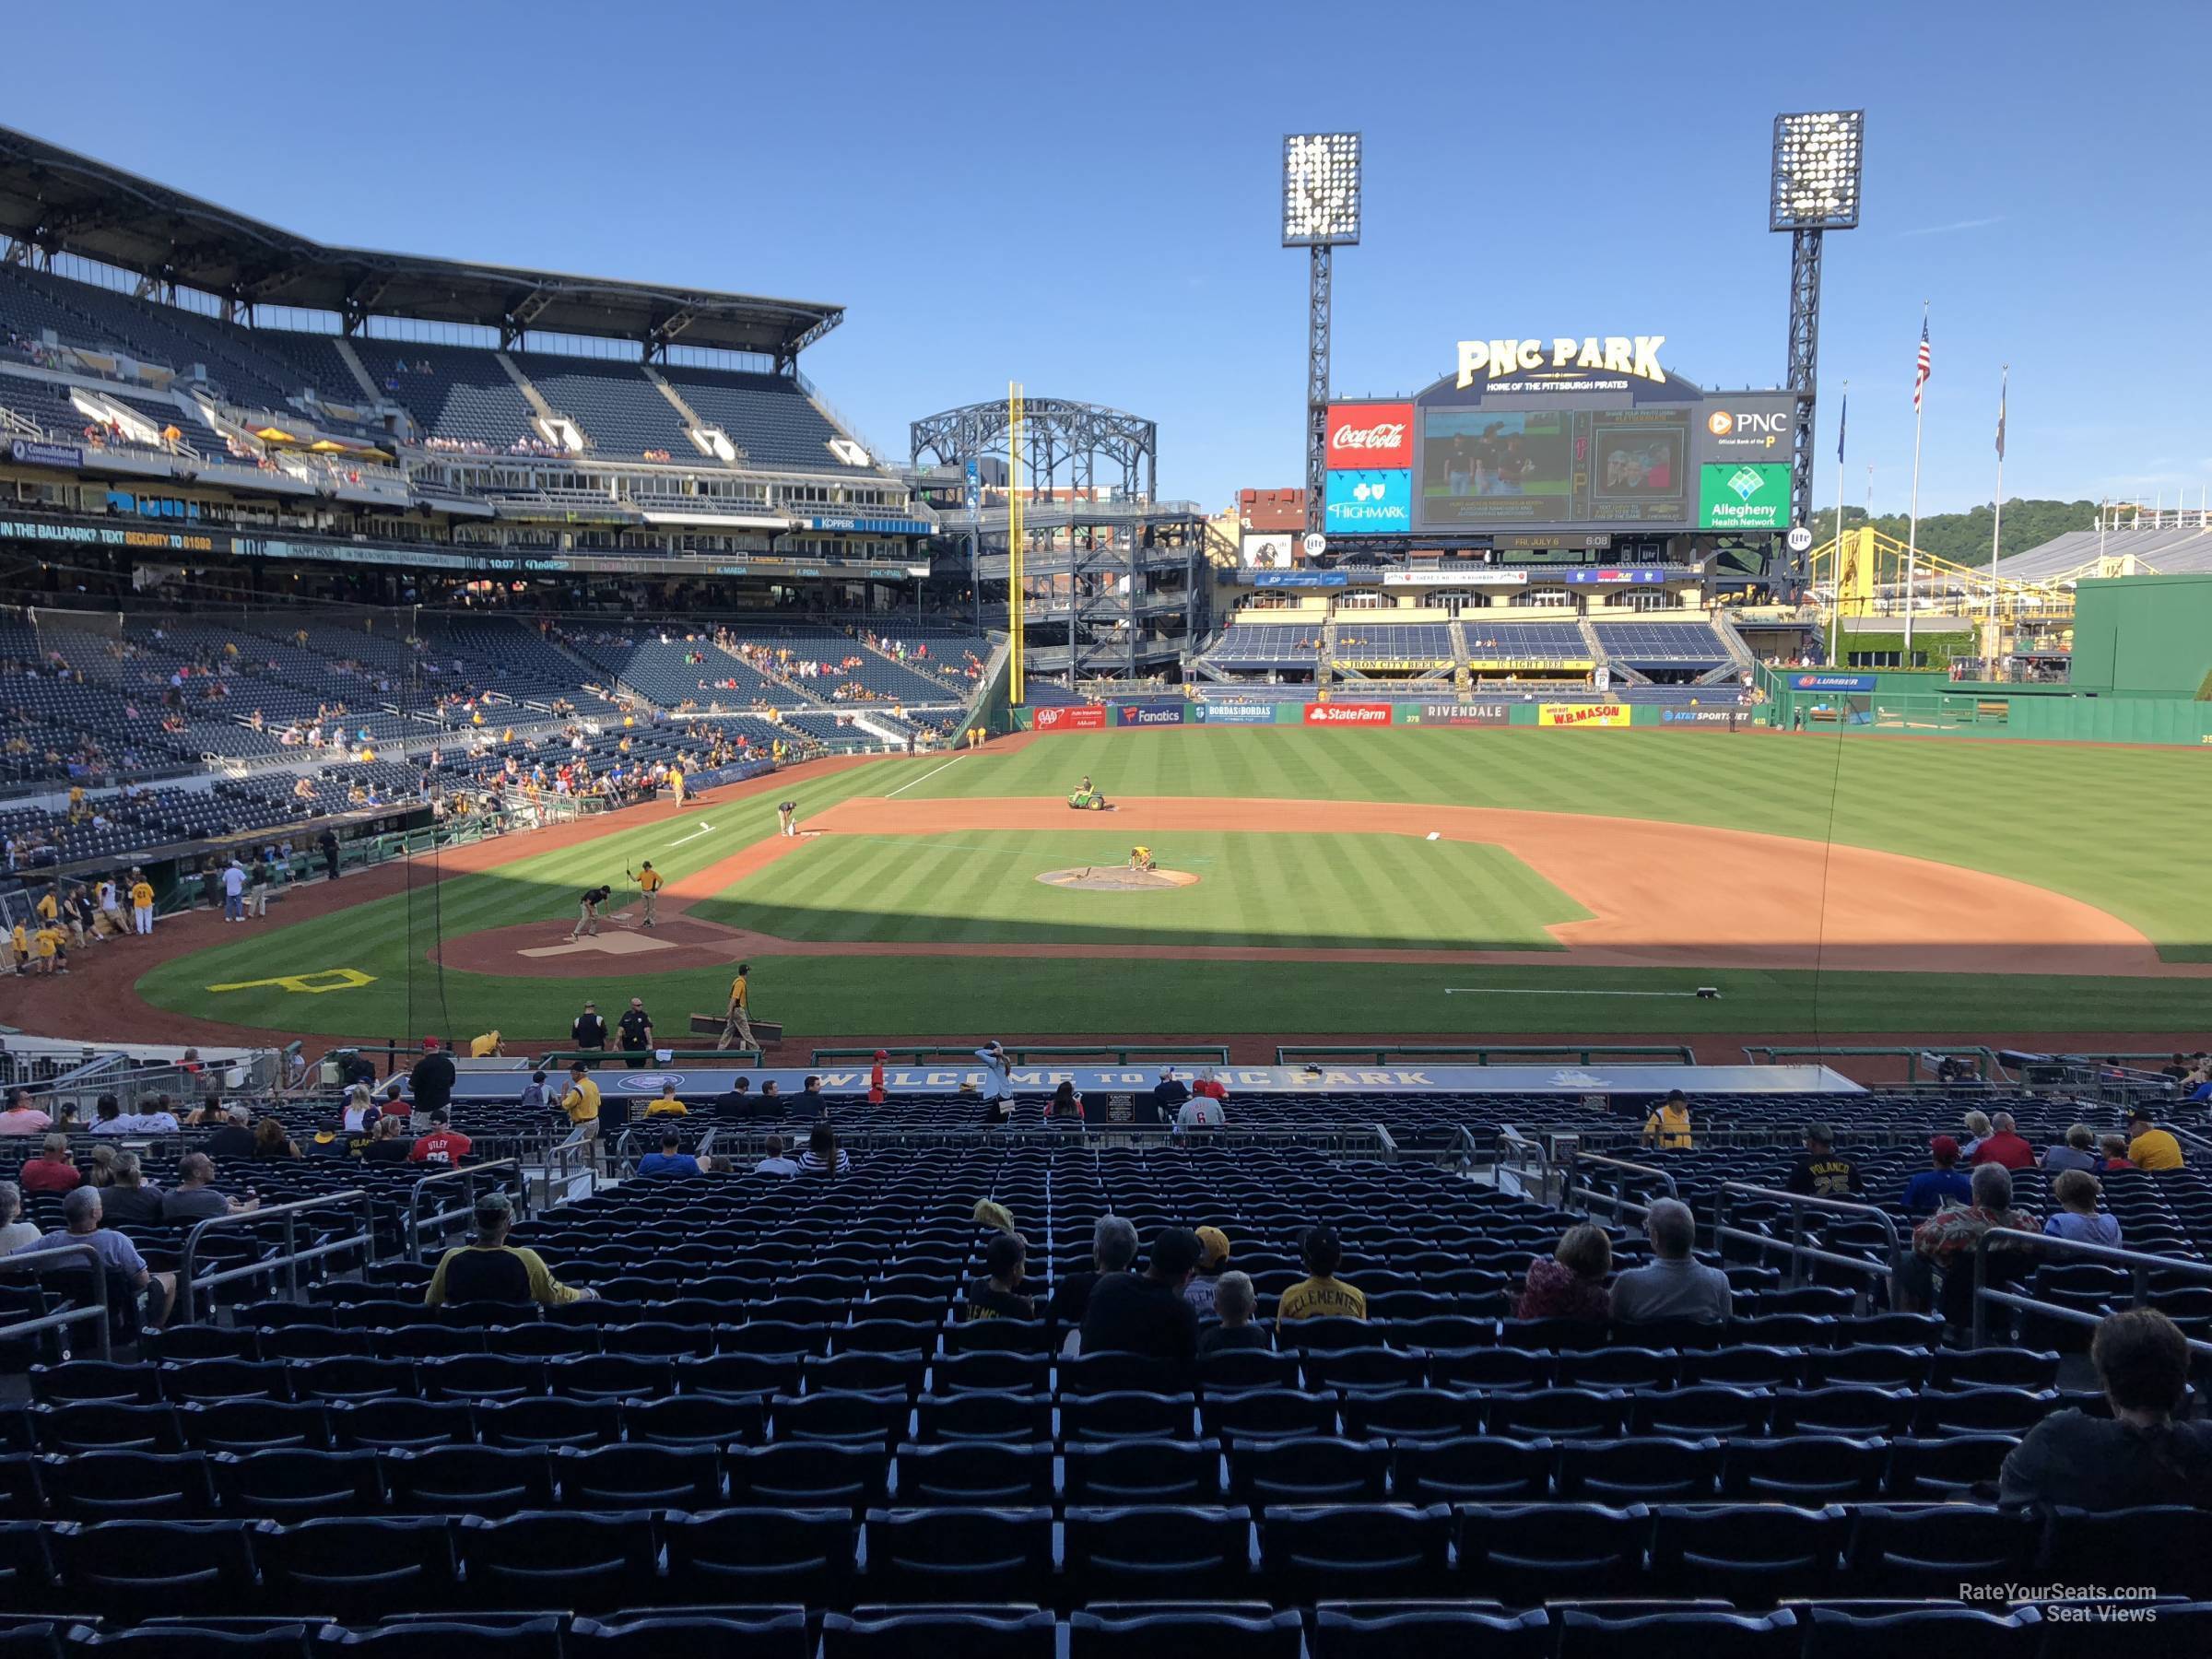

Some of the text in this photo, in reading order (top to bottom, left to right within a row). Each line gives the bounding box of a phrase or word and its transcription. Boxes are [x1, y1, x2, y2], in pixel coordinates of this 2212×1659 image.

[1456, 335, 1666, 389] PNC PARK
[1487, 381, 1629, 392] HOME OF THE PITTSBURGH PIRATES
[1736, 413, 1787, 432] PNC
[1333, 423, 1406, 449] Coca-Cola
[1336, 505, 1406, 519] HIGHMARK
[1712, 503, 1777, 517] Allegheny
[822, 518, 854, 528] KOPPERS
[1712, 518, 1775, 526] Health Network
[0, 523, 13, 536] IN
[15, 523, 36, 538] THE
[38, 524, 96, 542] BALLPARK?
[100, 529, 124, 544] TEXT
[125, 531, 170, 547] SECURITY
[170, 535, 182, 548] TO
[1586, 536, 1608, 546] 6:08
[1791, 534, 1809, 545] Lite
[1307, 539, 1324, 549] Lite
[1515, 537, 1559, 547] FRI, JULY 6
[489, 559, 514, 569] 10:07
[1817, 677, 1858, 686] LUMBER
[1209, 706, 1238, 715] BORDAS
[1241, 706, 1270, 715] BORDAS
[1429, 706, 1502, 717] RIVENDALE
[1038, 712, 1057, 722] AAA
[1138, 710, 1180, 723] Fanatics
[1093, 1073, 1144, 1083] TO
[1289, 1071, 1435, 1085] PARK
[428, 1139, 448, 1150] UTLEY
[1808, 1161, 1851, 1177] POLANCO
